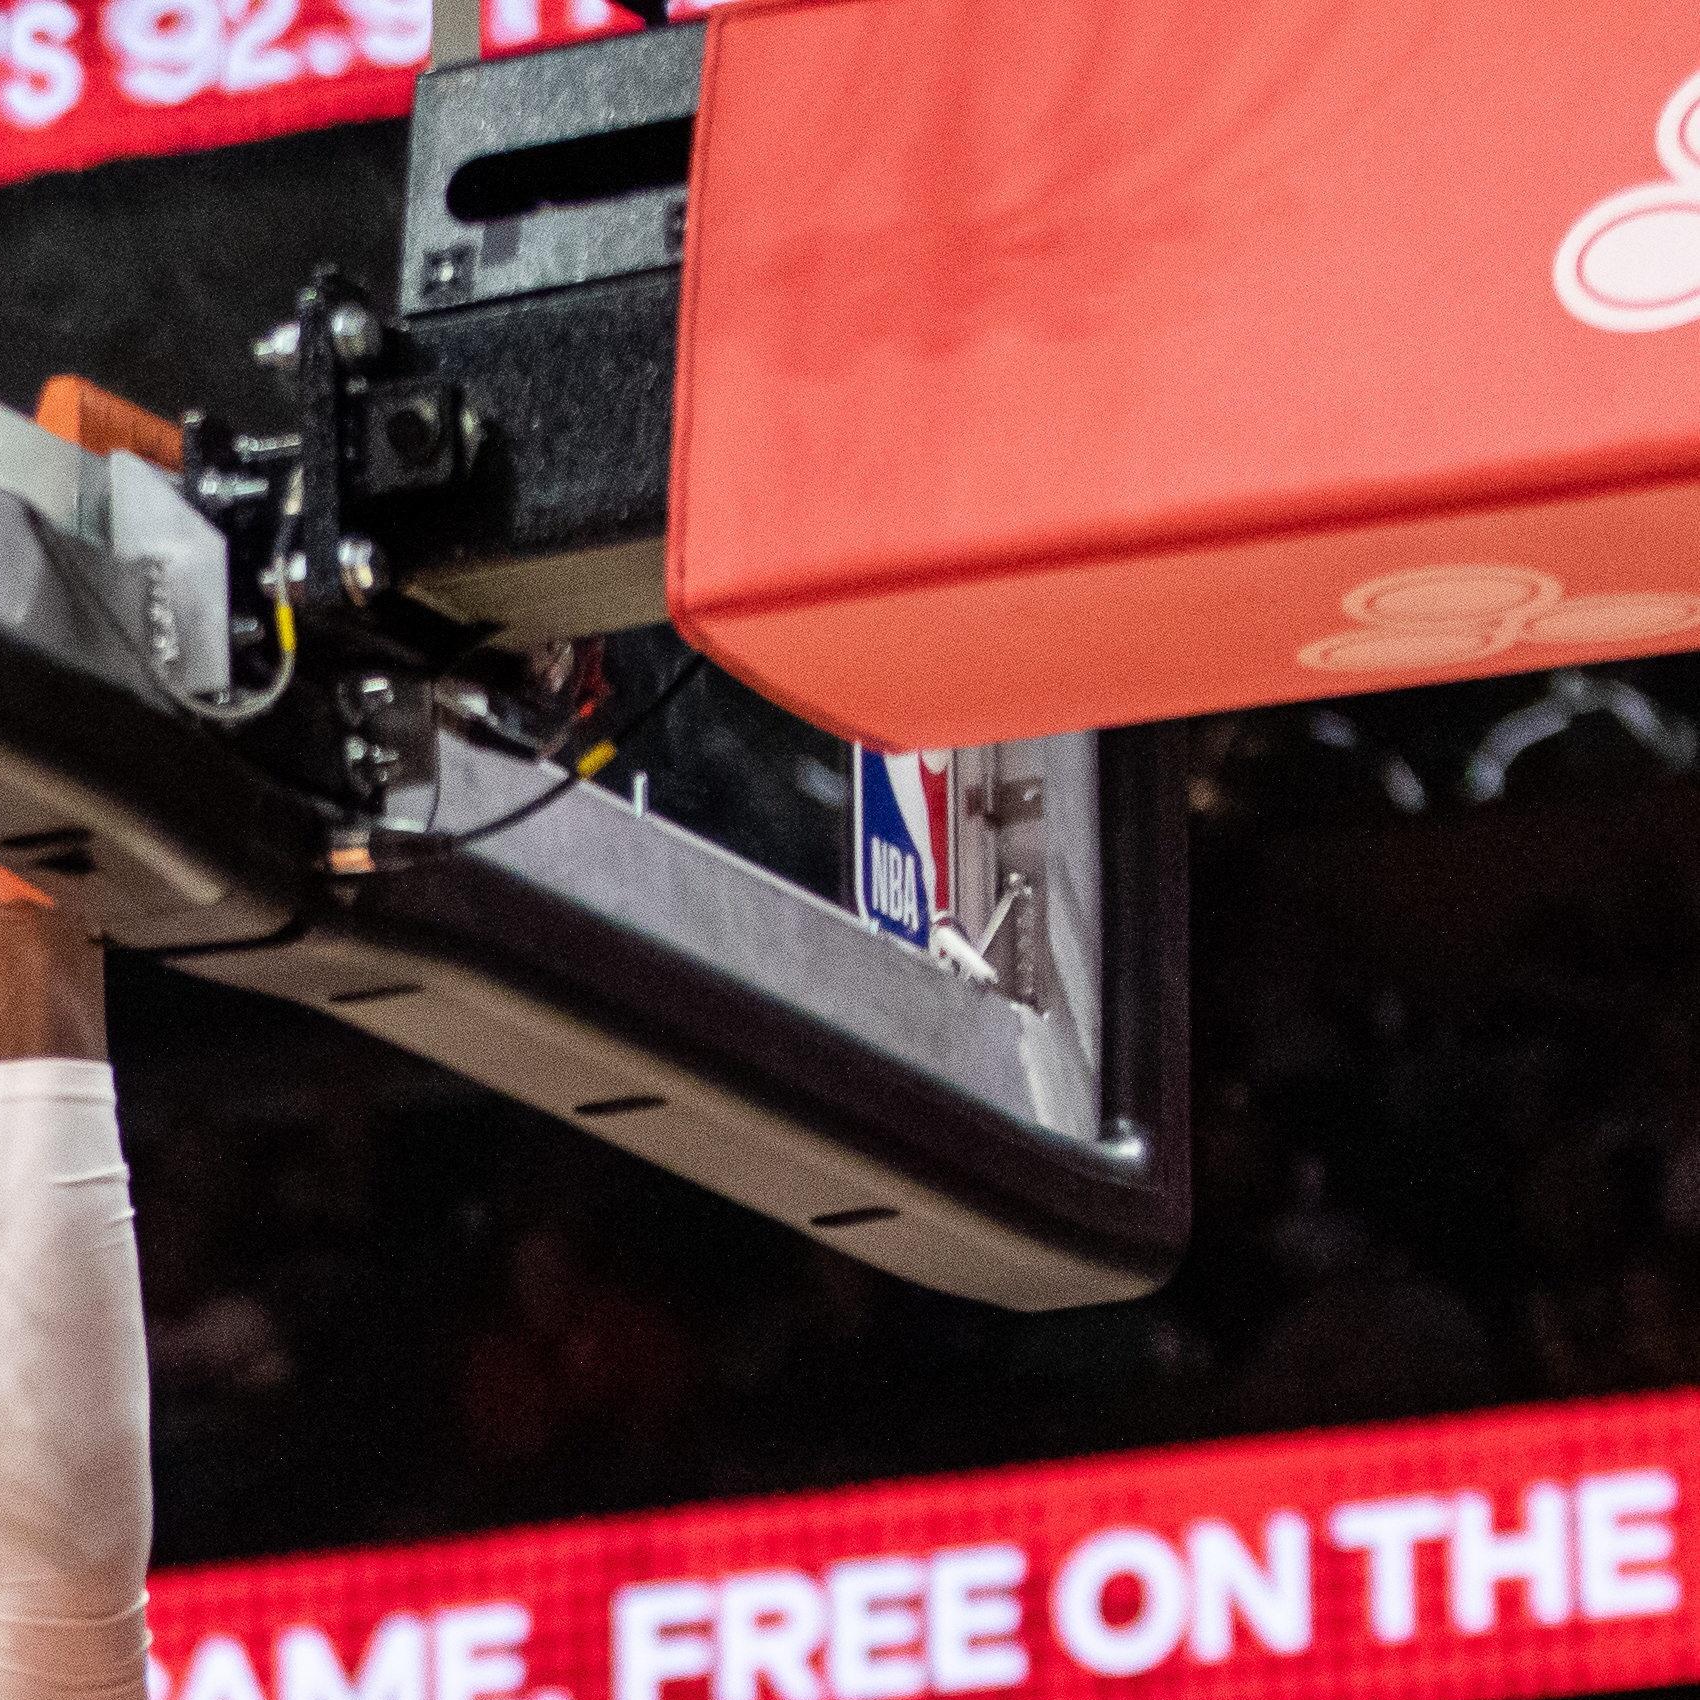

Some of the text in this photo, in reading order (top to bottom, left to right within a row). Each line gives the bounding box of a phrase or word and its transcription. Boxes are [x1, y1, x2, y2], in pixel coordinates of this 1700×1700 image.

[870, 834, 921, 933] NBA
[1053, 1511, 1311, 1675] ON
[1330, 1469, 1681, 1642] THE
